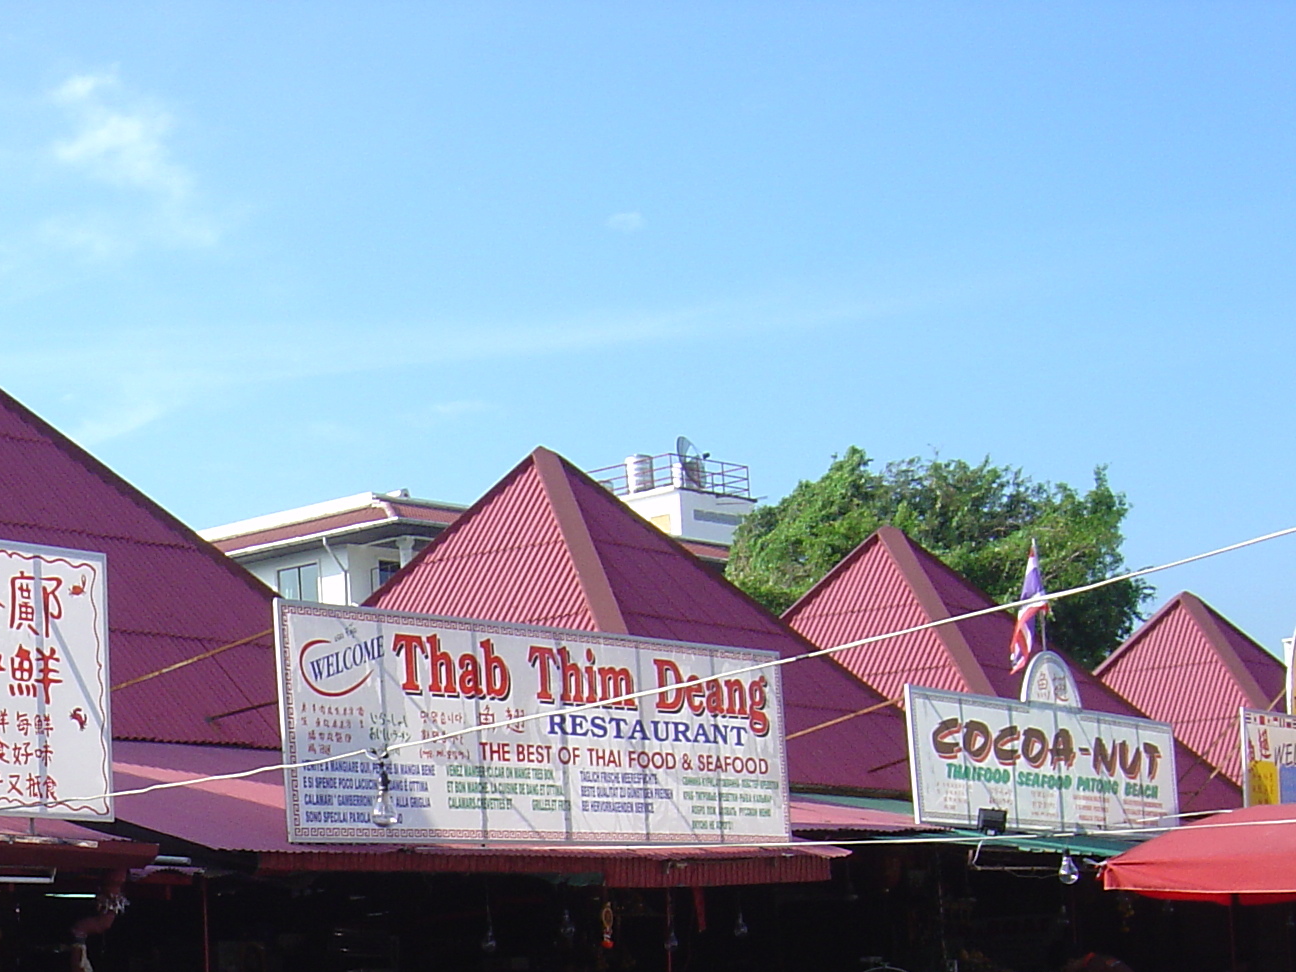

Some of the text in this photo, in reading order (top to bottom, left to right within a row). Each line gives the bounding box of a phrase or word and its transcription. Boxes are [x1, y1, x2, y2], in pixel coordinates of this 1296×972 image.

[310, 635, 386, 683] WELCOME
[392, 633, 770, 739] Thab Thim Deang
[548, 713, 748, 747] RESTAURANT
[931, 717, 1163, 782] COCOA-NUT
[480, 742, 511, 763] THE
[516, 743, 553, 765] BEST
[557, 746, 581, 766] OF
[587, 748, 622, 768] THAI
[628, 750, 677, 770] FOOD
[682, 753, 693, 771] &
[697, 754, 769, 775] SEAFOOD
[1015, 770, 1073, 792] SEAFOOD
[1076, 776, 1120, 796] PATONG
[1124, 782, 1160, 800] BEACH
